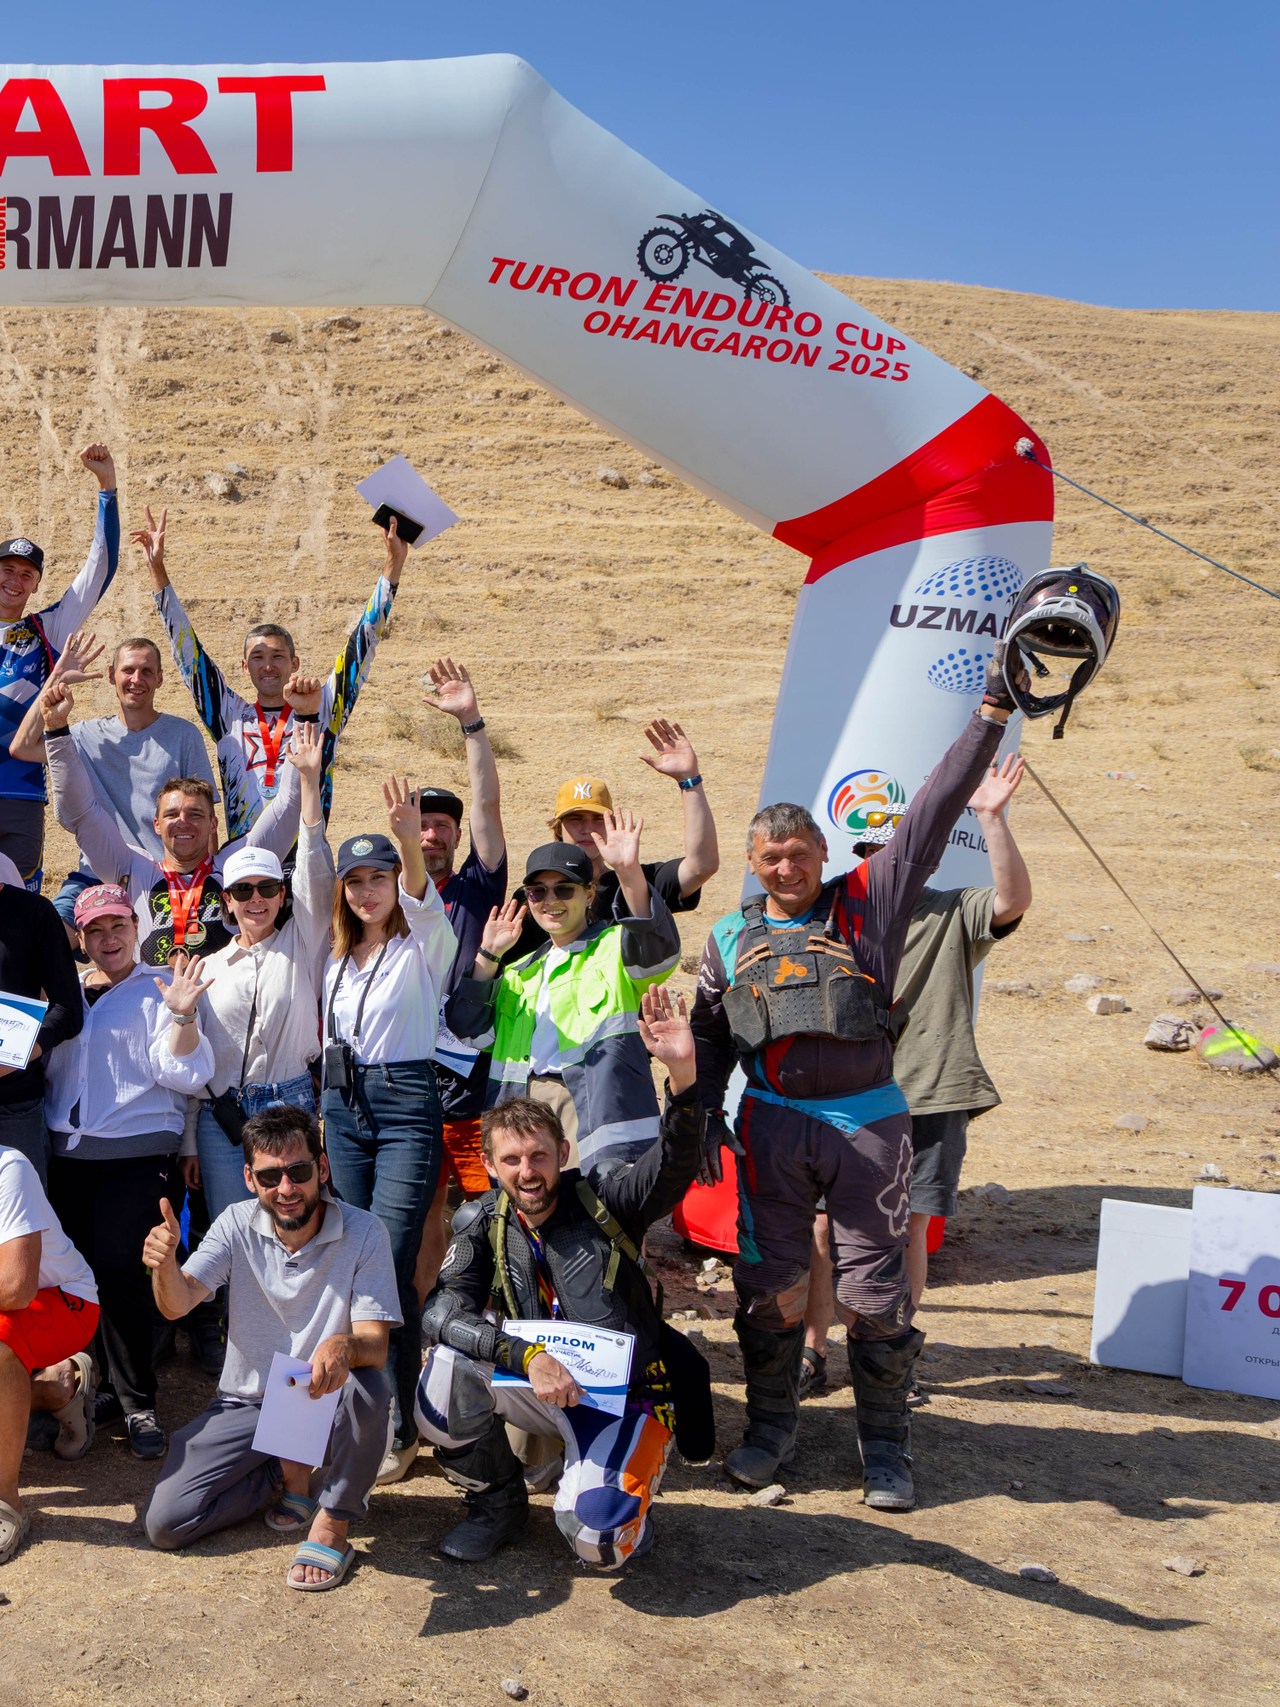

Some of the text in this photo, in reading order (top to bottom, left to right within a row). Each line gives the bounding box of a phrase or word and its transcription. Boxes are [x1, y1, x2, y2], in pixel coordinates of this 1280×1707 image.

[488, 257, 907, 355] TURON ENDURO CUP
[583, 310, 911, 382] OHANGARON 2025
[889, 604, 1006, 639] UZMA
[1218, 1279, 1246, 1311] 7
[536, 1335, 595, 1351] DIPLOM
